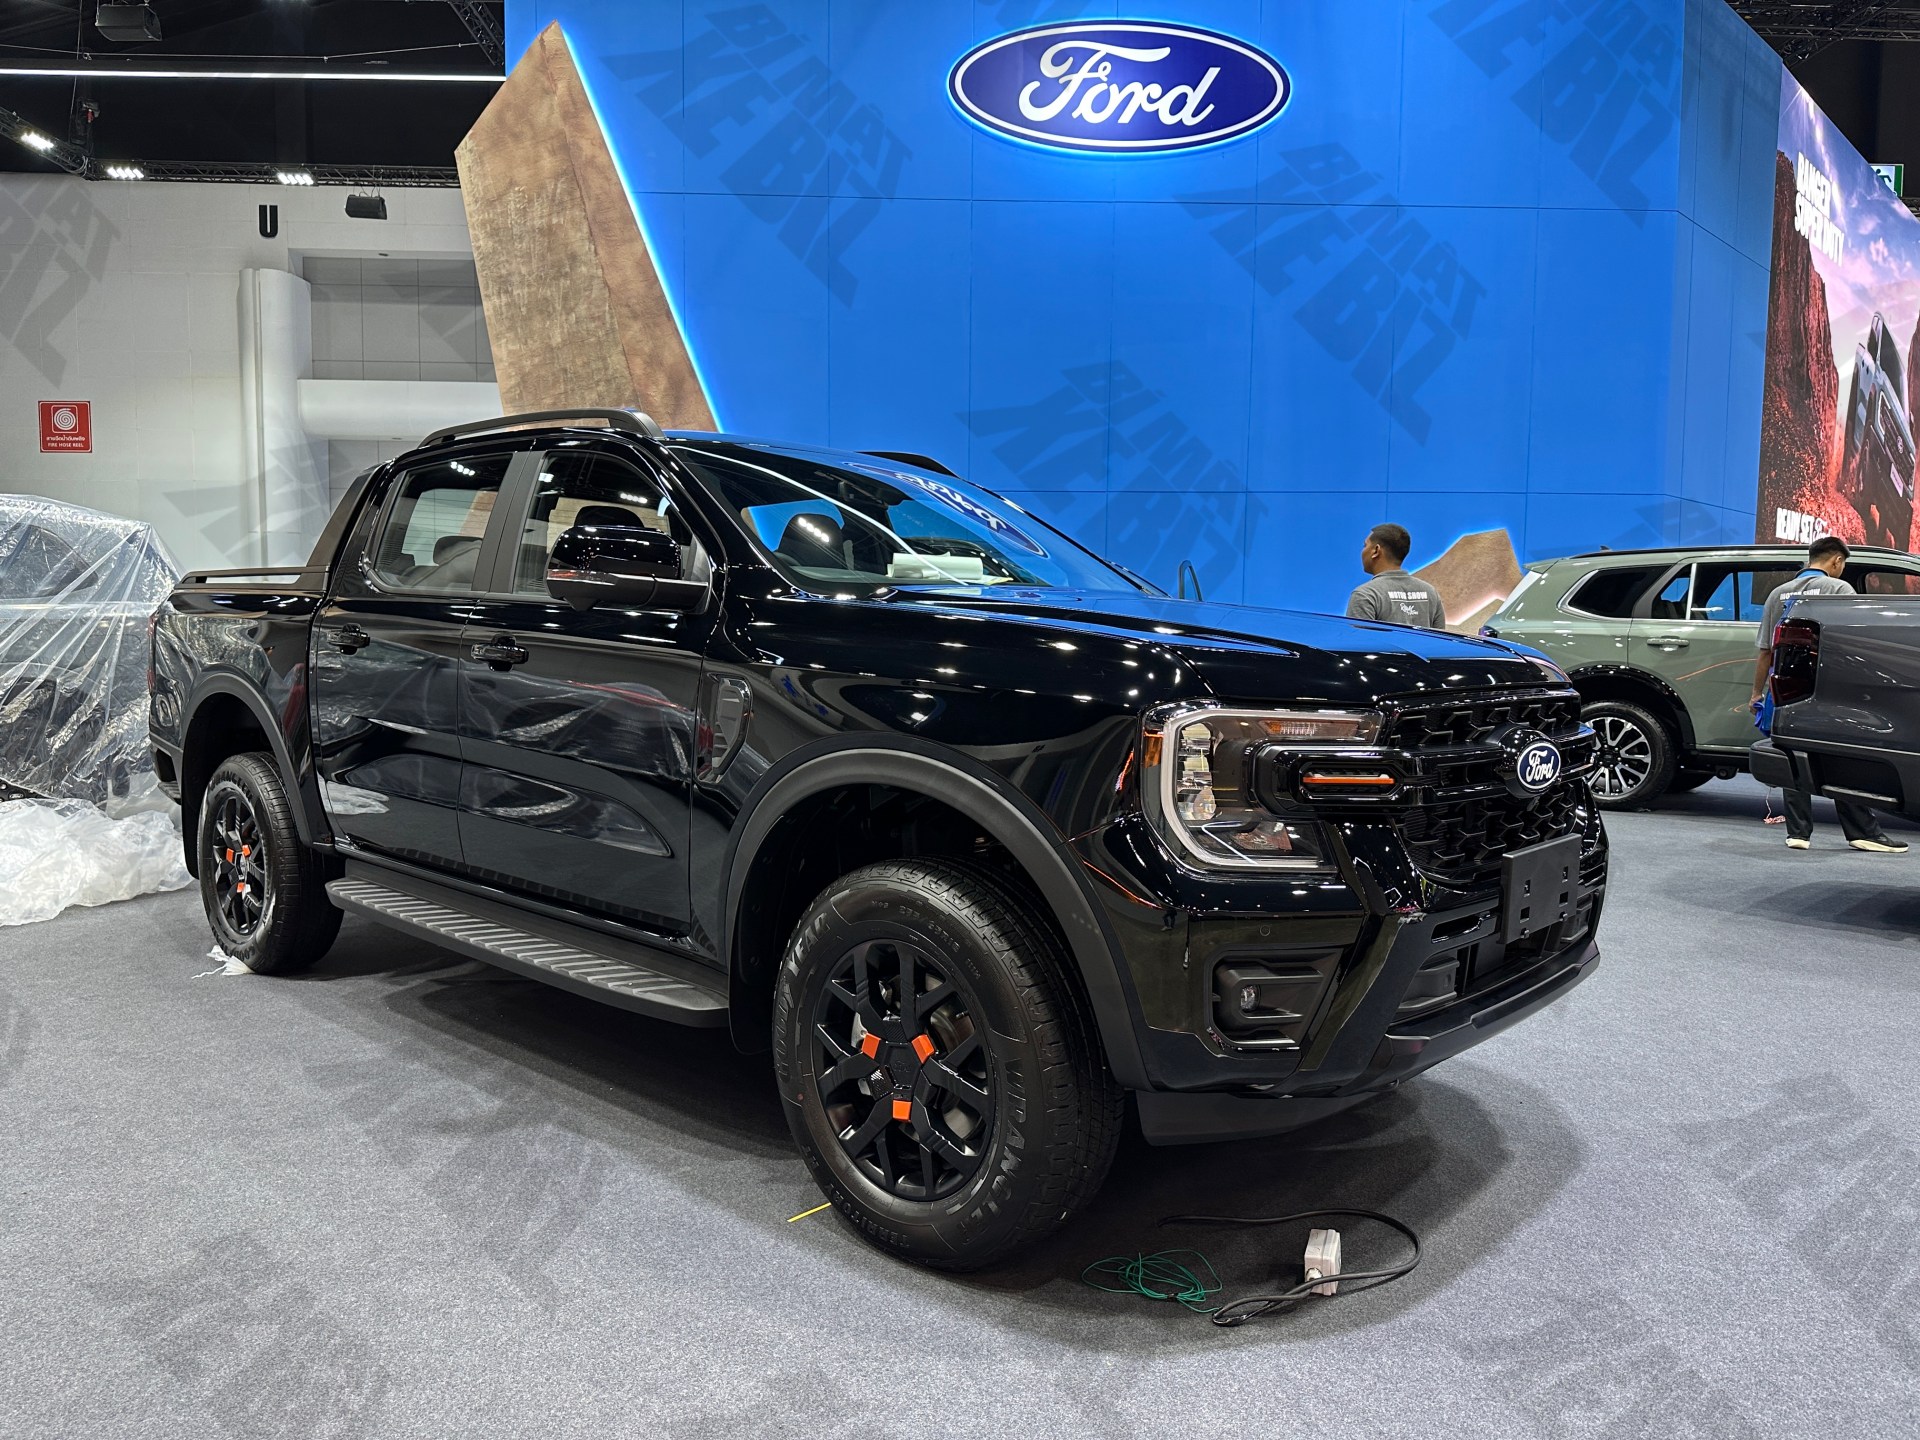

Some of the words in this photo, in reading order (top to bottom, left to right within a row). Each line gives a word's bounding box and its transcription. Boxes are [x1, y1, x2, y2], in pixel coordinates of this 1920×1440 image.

[1018, 40, 1221, 126] Ford
[258, 204, 279, 238] U
[1775, 507, 1802, 542] READY
[1800, 513, 1815, 545] SET
[1407, 591, 1428, 600] SHOW
[1526, 749, 1555, 783] Ford
